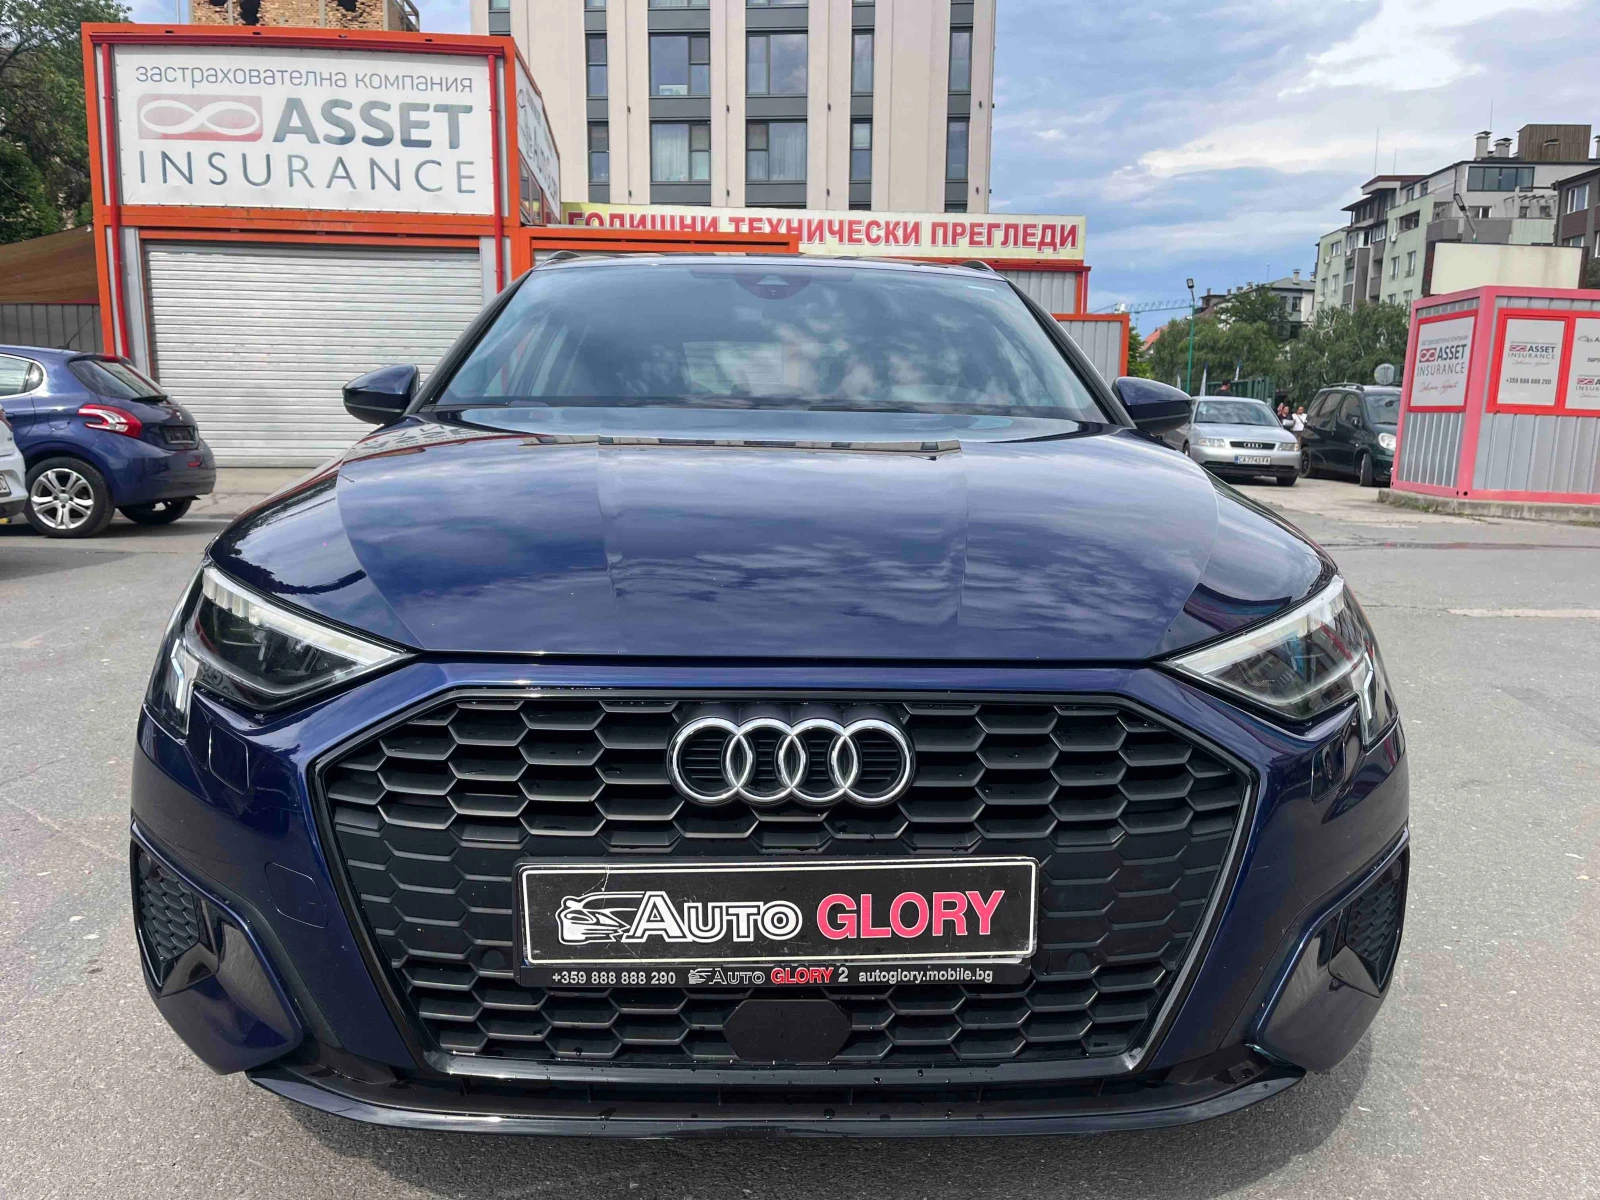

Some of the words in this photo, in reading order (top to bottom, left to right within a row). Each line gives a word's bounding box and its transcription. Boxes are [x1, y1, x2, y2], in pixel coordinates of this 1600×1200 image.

[136, 65, 348, 88] застрахователна
[355, 73, 473, 93] компания
[272, 96, 473, 150] ASSET
[139, 150, 476, 194] INSURANCE
[728, 215, 921, 247] ТЕХНИЧЕСКИ
[930, 221, 1079, 253] ПРЕГЛЕДИ
[1437, 343, 1467, 361] ASSET
[1528, 345, 1557, 353] ASSET
[1416, 361, 1465, 377] INSURANCE
[816, 890, 1006, 941] GLORY
[552, 971, 587, 985] +359
[591, 972, 617, 985] 888
[621, 972, 646, 985] 888
[650, 972, 676, 985] 290
[770, 967, 834, 984] GLORY
[838, 968, 848, 983] 2
[858, 967, 993, 984] autoglory.mobile.bg
